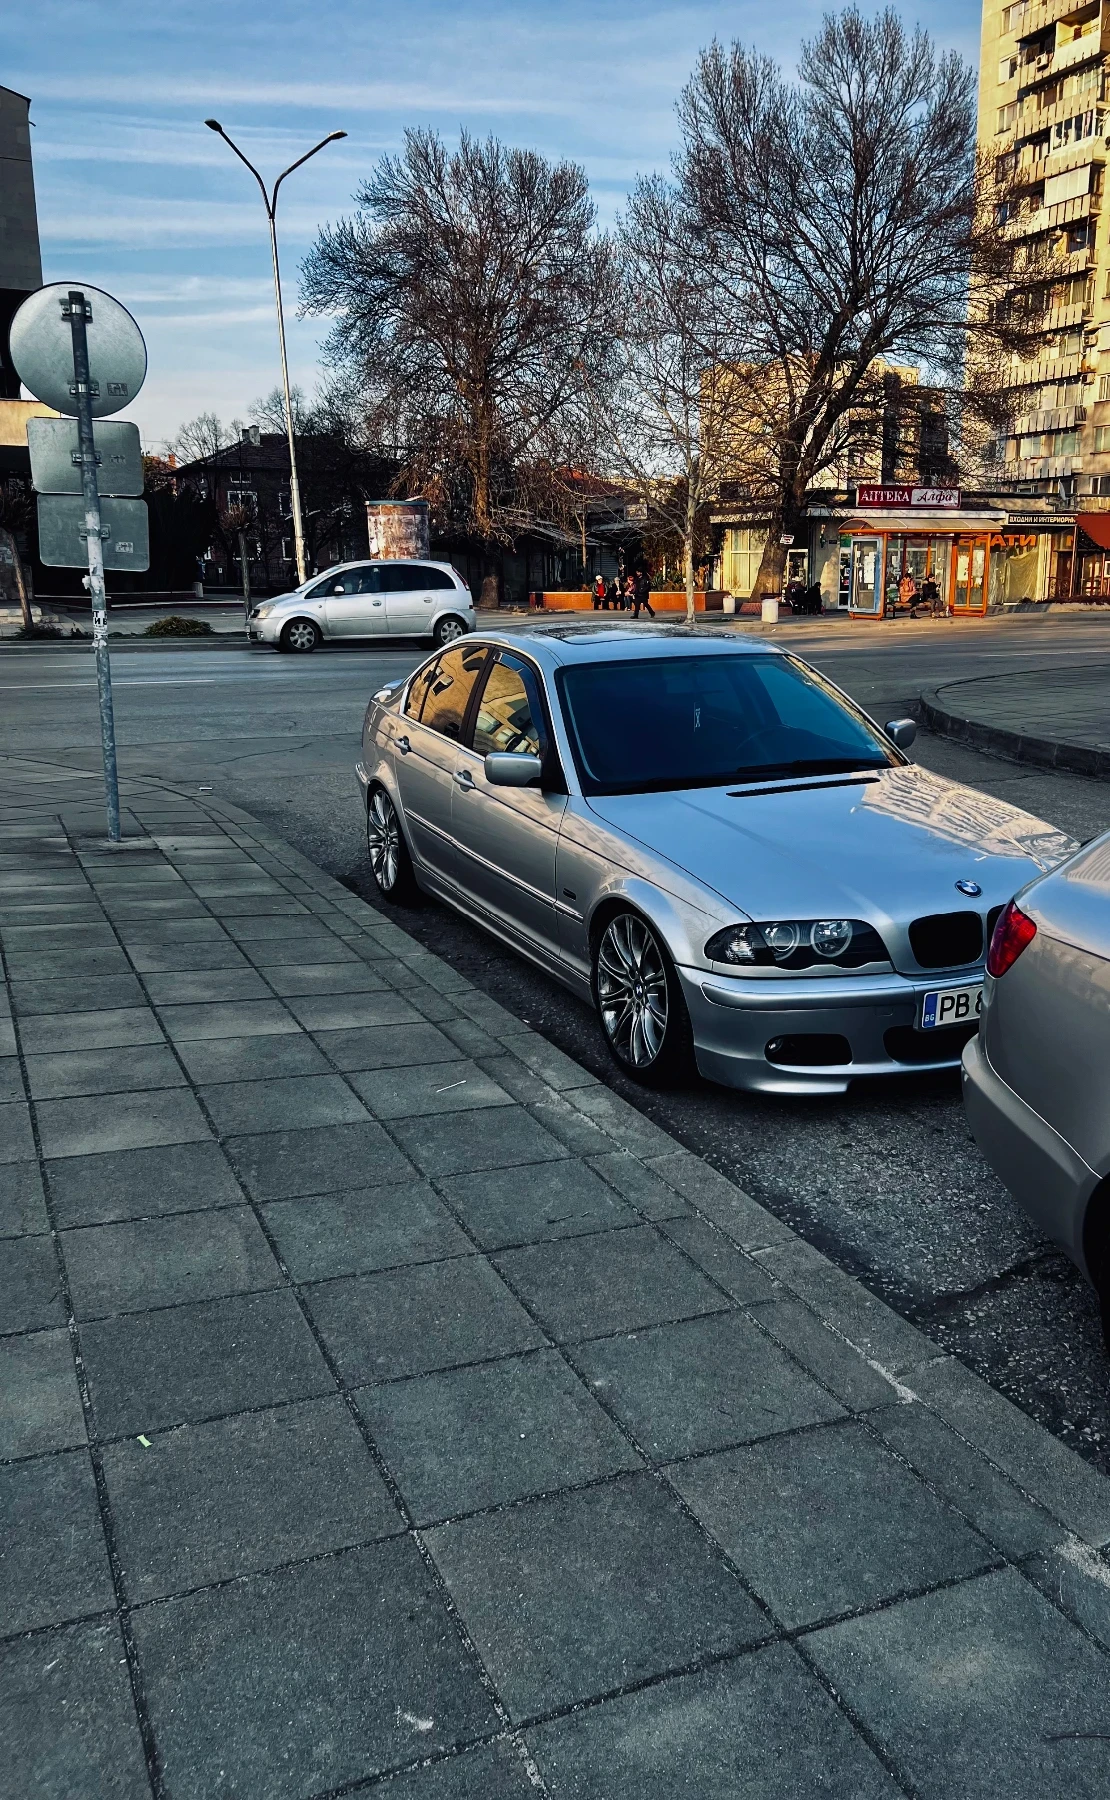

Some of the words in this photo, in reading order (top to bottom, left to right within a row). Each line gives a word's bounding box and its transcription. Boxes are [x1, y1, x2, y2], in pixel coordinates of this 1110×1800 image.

[860, 490, 910, 502] АПТЕКА
[916, 489, 953, 504] Алфа
[939, 993, 970, 1021] PB
[924, 1013, 935, 1022] BG
